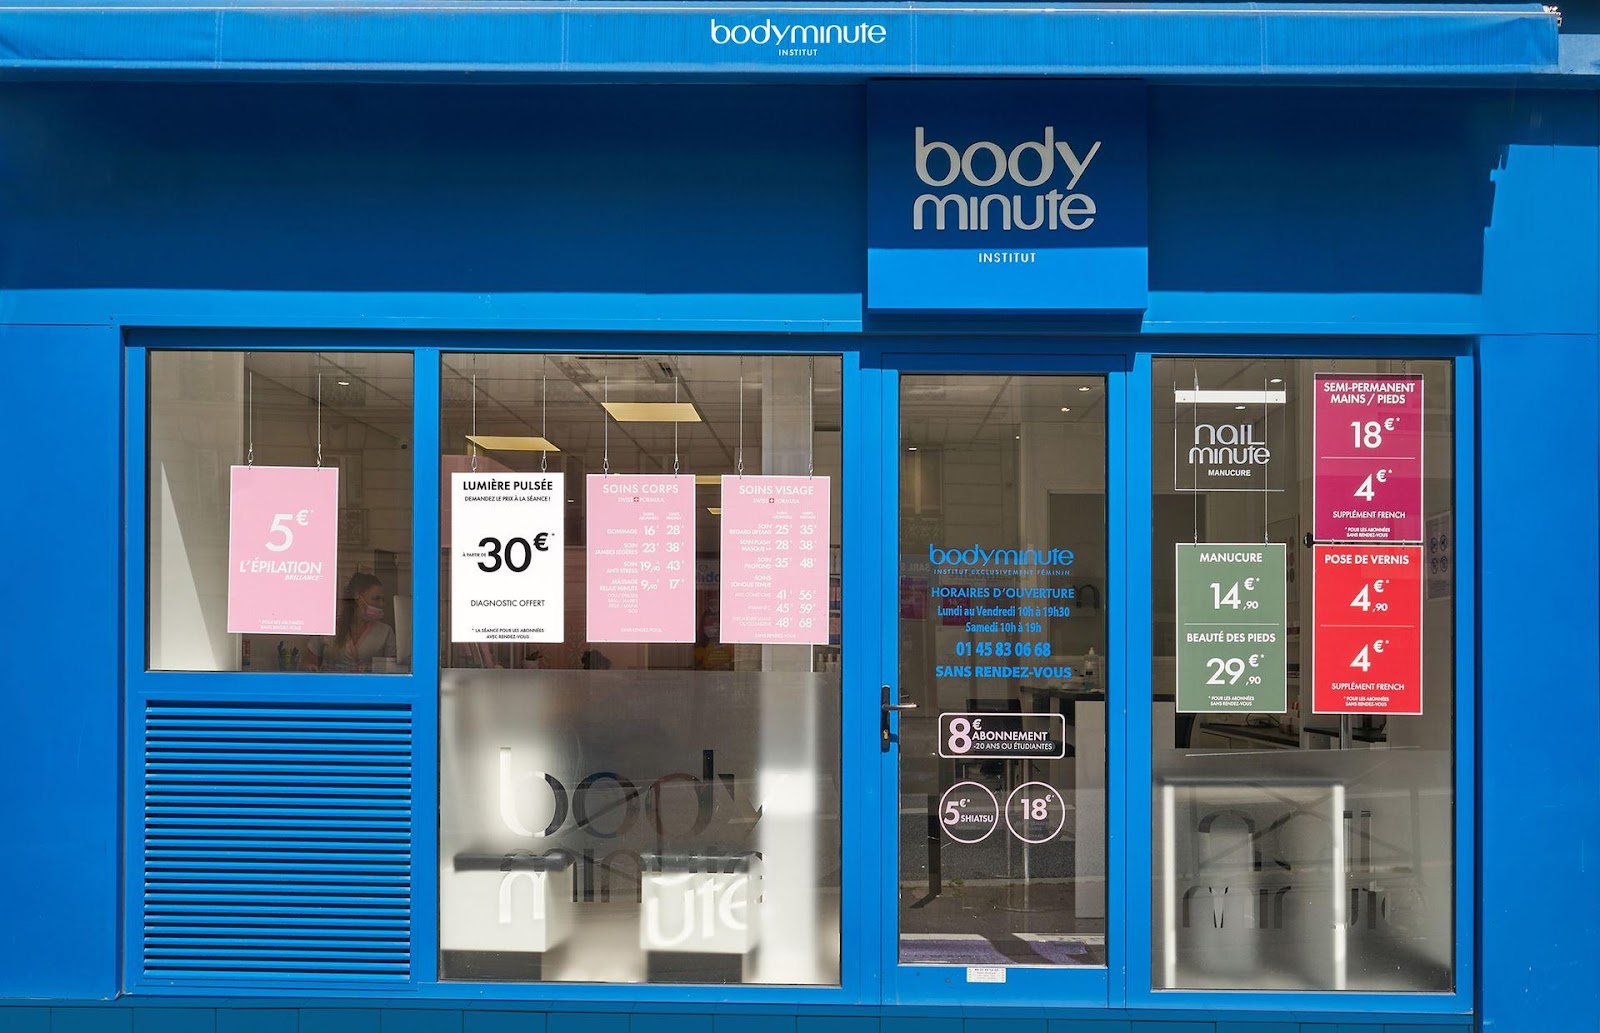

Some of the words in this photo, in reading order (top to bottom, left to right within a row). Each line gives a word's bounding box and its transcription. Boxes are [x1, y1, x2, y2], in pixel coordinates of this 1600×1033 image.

[711, 19, 886, 45] bodyminute
[915, 126, 1101, 190] body
[913, 189, 1096, 230] minute
[978, 252, 1036, 263] INSTITUT
[1324, 382, 1415, 392] SEMI-PERMANENT
[1330, 394, 1366, 404] MAINS
[1377, 394, 1406, 404] PIEDS
[1189, 445, 1271, 465] minute
[1208, 469, 1251, 477] MANUCURE
[463, 478, 510, 490] LUMIÈRE
[514, 478, 553, 490] PULSÉE
[603, 484, 639, 494] SOINS
[642, 484, 679, 494] CORPS
[739, 485, 773, 494] SOINS
[775, 486, 814, 495] VISAGE
[514, 494, 519, 502] À
[1333, 510, 1376, 519] SUPPLÉMENT
[1377, 511, 1406, 519] FRENCH
[929, 543, 1074, 566] bodyminute
[1200, 553, 1263, 562] MANUCURE
[1324, 554, 1352, 564] POSE
[1354, 555, 1368, 564] DE
[1370, 555, 1409, 565] VERNIS
[239, 557, 322, 574] L'ÉPILATION
[1037, 568, 1070, 576] FÉMININ
[931, 587, 990, 599] HORAIRES
[993, 587, 1075, 599] D'OUVERTURE
[470, 599, 517, 607] DIAGNOSTIC
[519, 599, 546, 607] OFFERT
[937, 606, 962, 617] Lundi
[964, 608, 975, 617] au
[977, 606, 1016, 617] Vendredi
[1018, 606, 1033, 617] 10h
[1035, 607, 1041, 617] à
[1043, 606, 1070, 617] 19h30
[965, 622, 998, 633] Samedi
[1000, 622, 1016, 633] 10h
[1018, 622, 1024, 633] à
[1026, 622, 1041, 633] 19h
[1187, 631, 1224, 642] BEAUTÉ
[1226, 633, 1245, 642] DES
[1248, 633, 1276, 642] PIEDS
[956, 642, 971, 657] 01
[975, 642, 992, 657] 45
[995, 642, 1012, 657] 83
[1015, 642, 1031, 657] 06
[1034, 642, 1051, 657] 68
[936, 666, 972, 678] SANS
[975, 666, 1072, 678] RENDEZ-VOUS
[1331, 681, 1375, 690] SUPPLÉMENT
[972, 731, 1048, 741] ABONNEMENT
[1013, 741, 1053, 750] ÉTUDIANTES
